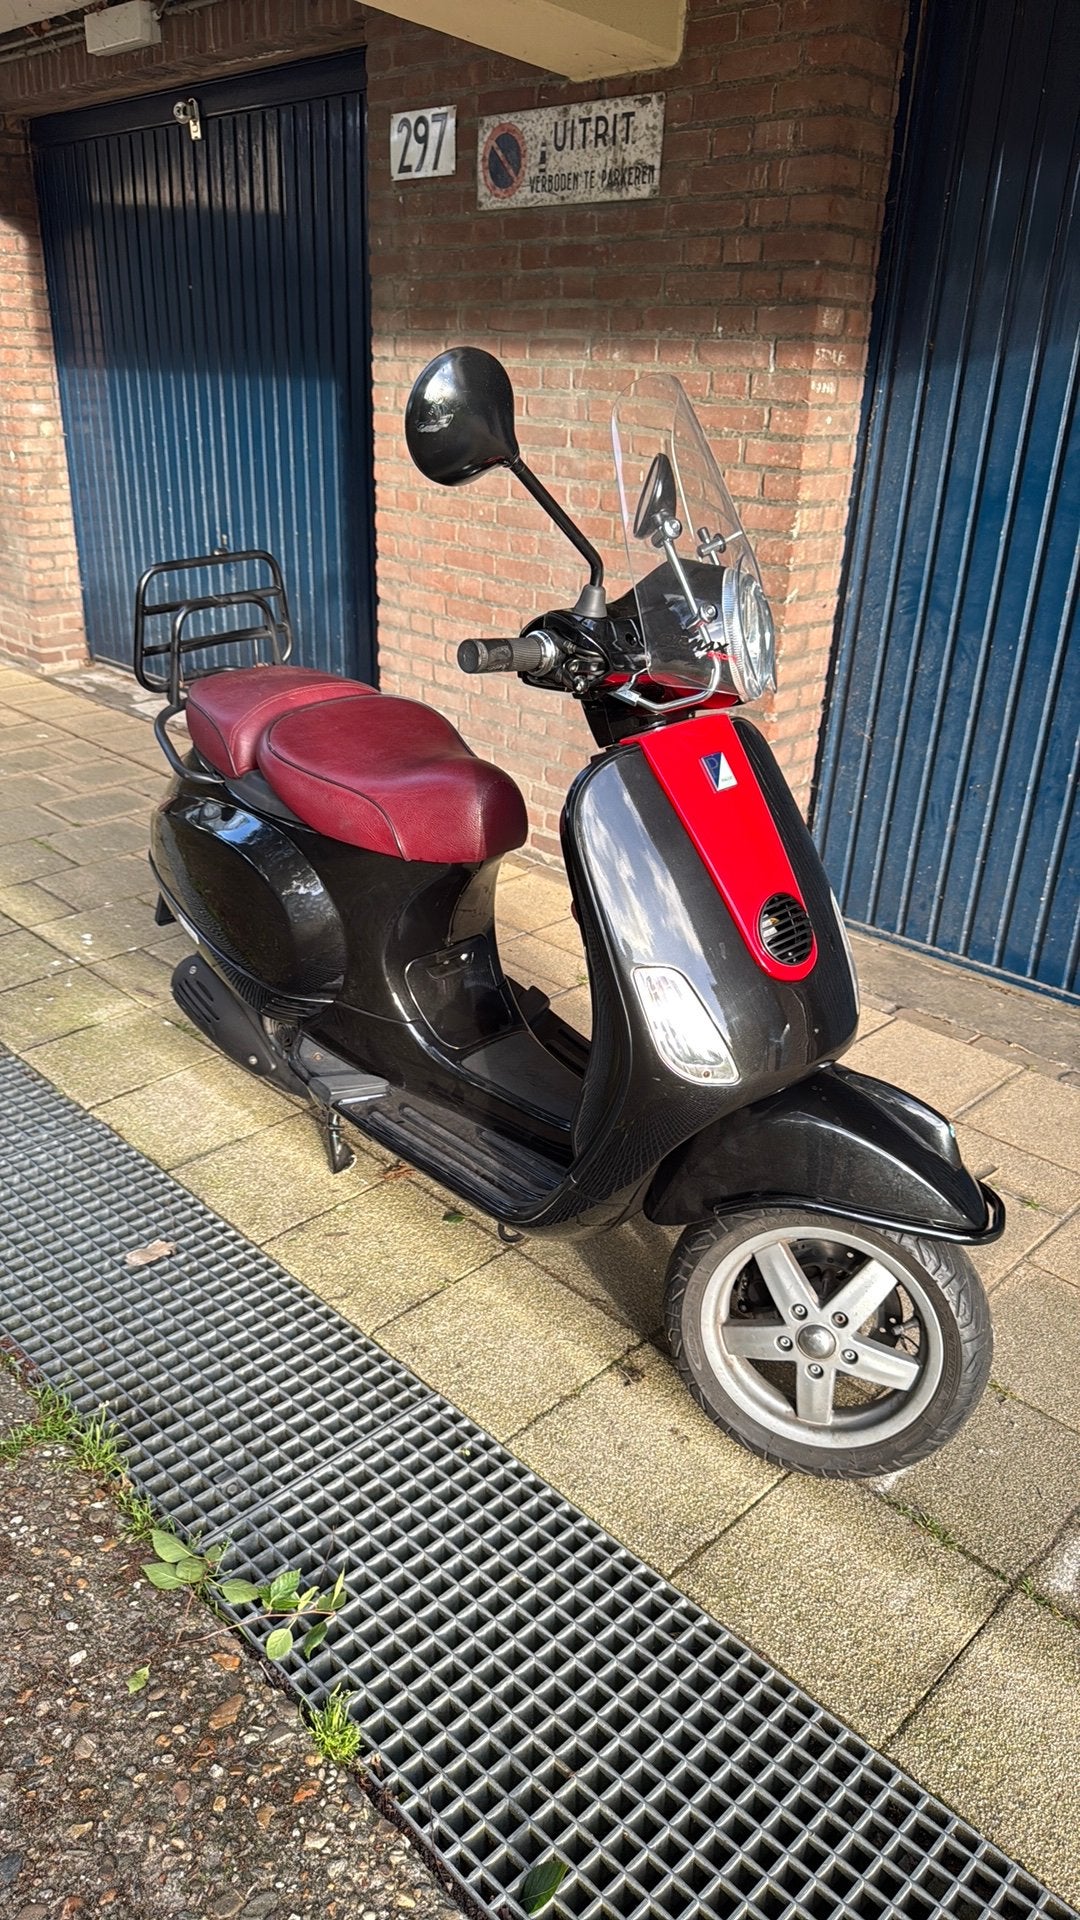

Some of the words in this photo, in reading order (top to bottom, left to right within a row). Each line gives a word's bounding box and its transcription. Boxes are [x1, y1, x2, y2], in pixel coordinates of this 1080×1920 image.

[397, 112, 448, 174] 297
[554, 111, 636, 152] UITRIT
[529, 172, 578, 193] VERBODEN
[584, 170, 596, 189] TE
[601, 165, 655, 188] PARKEREN
